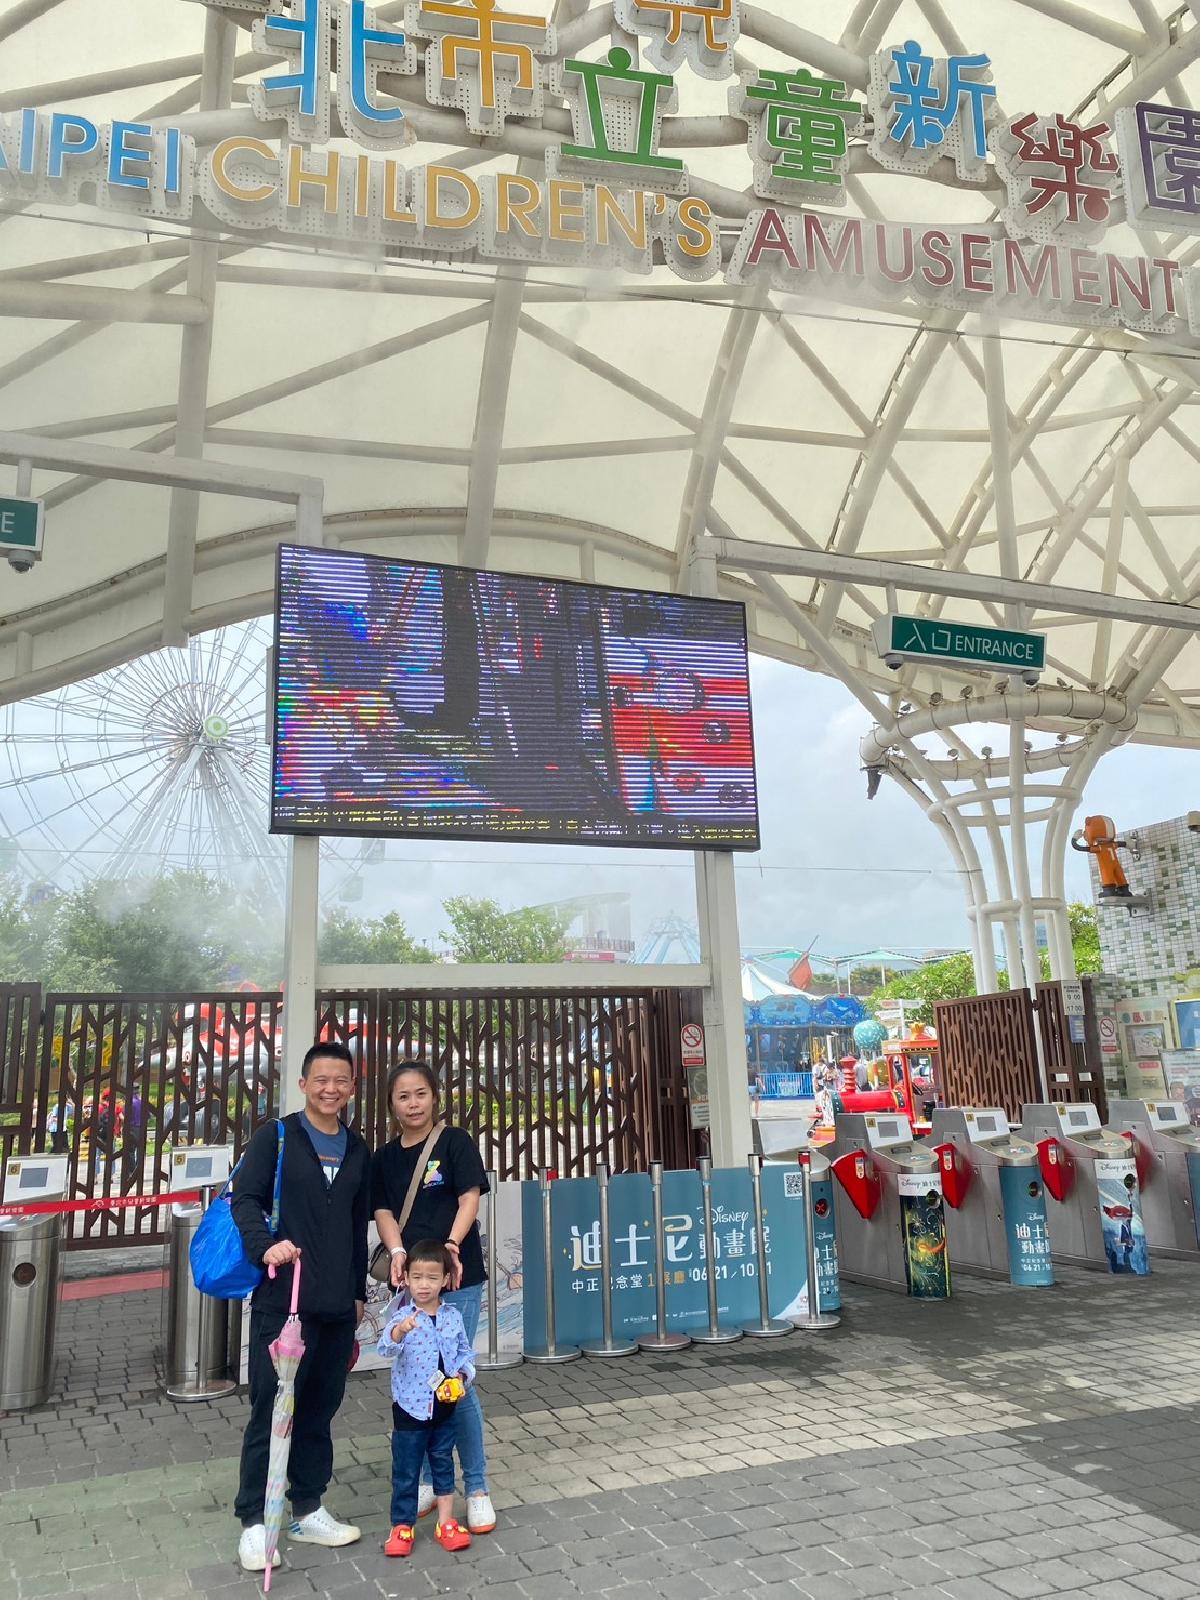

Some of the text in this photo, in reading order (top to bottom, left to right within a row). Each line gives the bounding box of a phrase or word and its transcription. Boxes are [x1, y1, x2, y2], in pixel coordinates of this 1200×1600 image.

[0, 107, 1180, 314] IPEI CHILDREN'S AMUSEMENT
[903, 622, 1034, 660] 入口 ENTRANCE
[571, 1273, 643, 1294] 中正念堂
